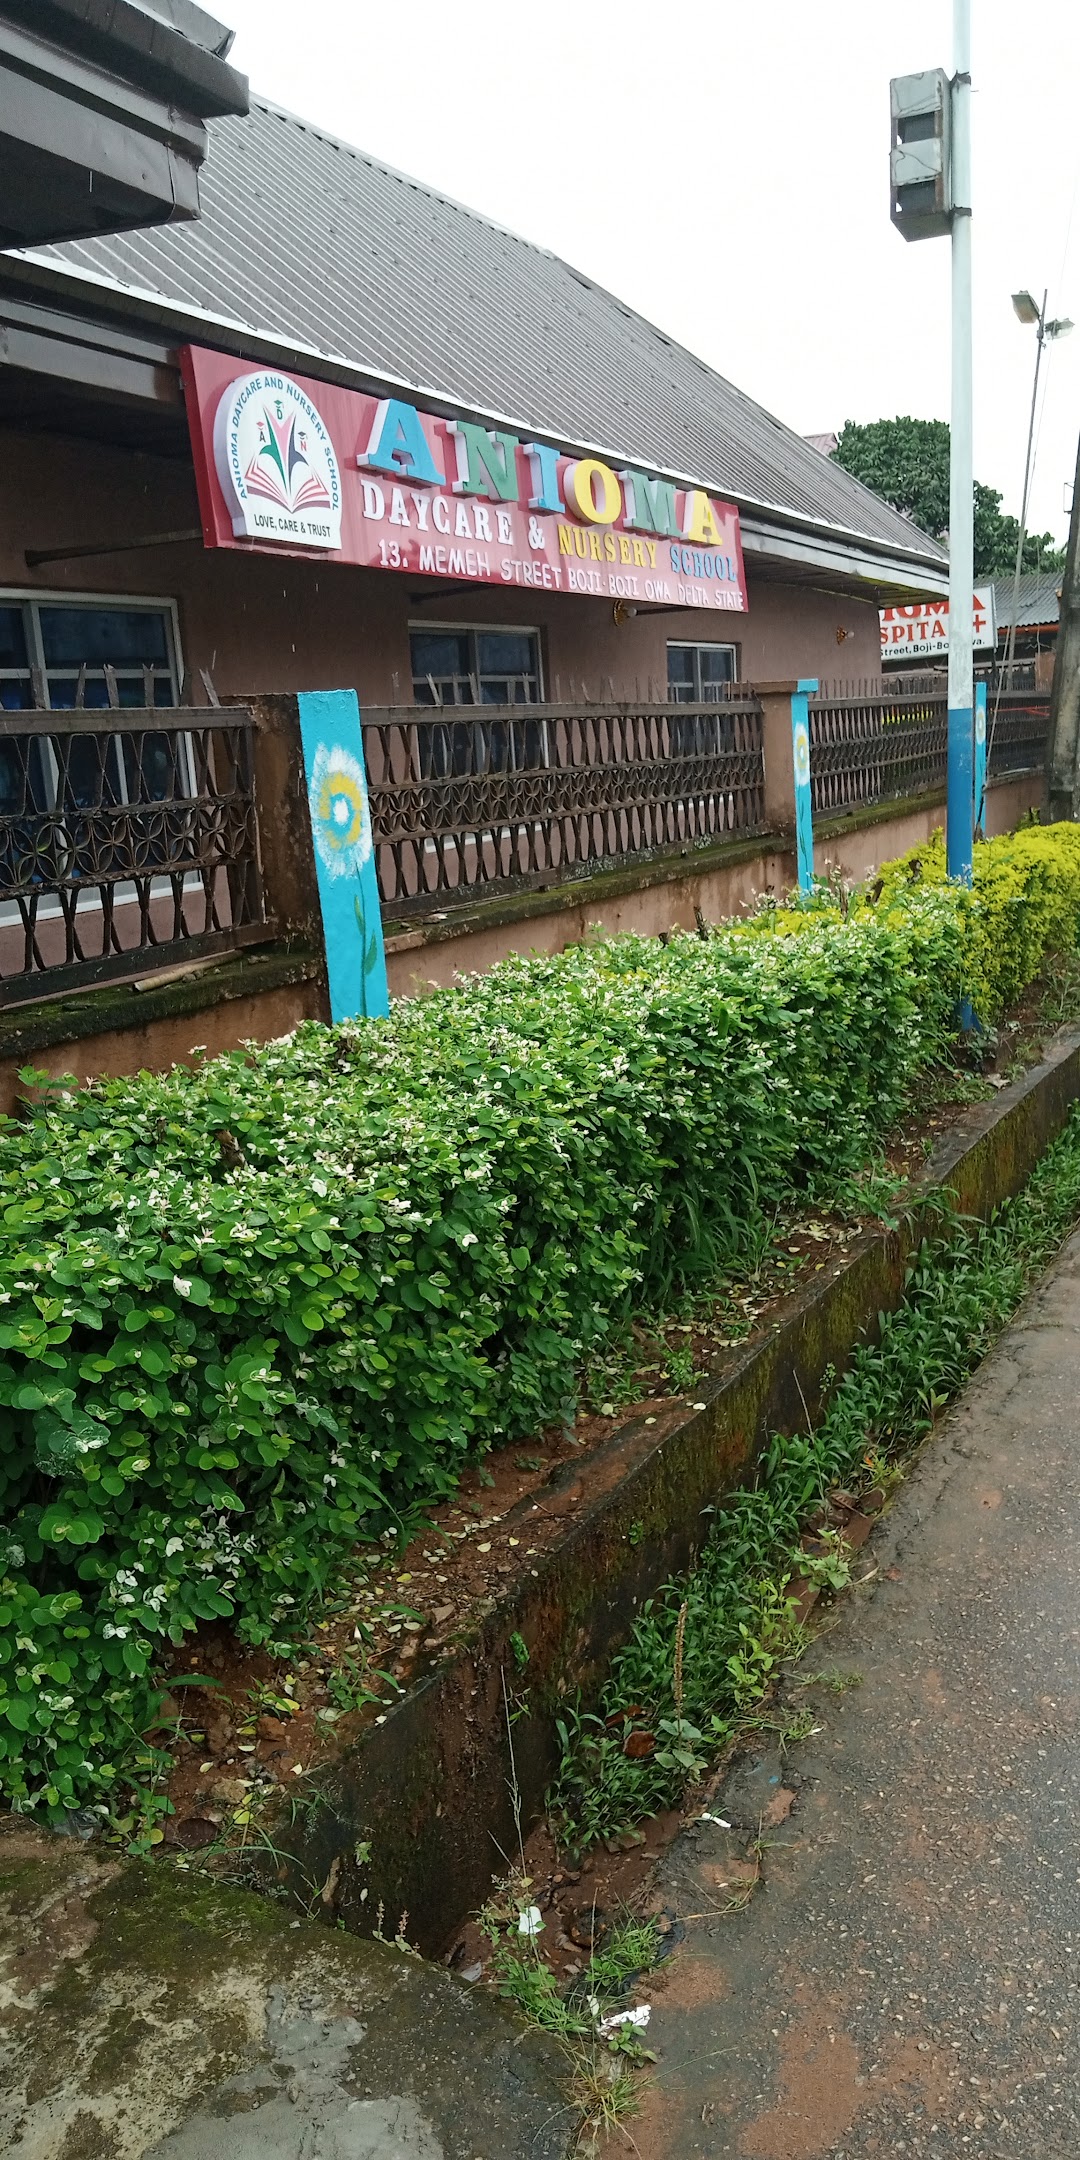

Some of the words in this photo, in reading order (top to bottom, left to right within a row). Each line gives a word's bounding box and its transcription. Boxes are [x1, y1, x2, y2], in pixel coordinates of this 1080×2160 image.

[264, 376, 284, 390] AND
[232, 378, 262, 428] DAYCARE
[276, 408, 283, 420] D
[286, 383, 326, 441] NURSERY
[259, 430, 267, 443] A
[300, 440, 307, 452] N
[231, 433, 247, 499] ANIOMA
[324, 447, 339, 511] SCHOOL
[356, 398, 723, 546] ANIOMA
[254, 514, 278, 531] LOVE,
[278, 518, 299, 532] CARE
[300, 523, 306, 533] &
[307, 523, 331, 537] TRUST
[360, 479, 514, 546] DAYCARE
[528, 515, 546, 550] &
[557, 524, 657, 569] NURSERY
[669, 545, 737, 582] SCHOOL
[419, 544, 491, 577] MEMEH
[500, 557, 562, 589] STREET
[644, 580, 671, 600] OWA
[678, 583, 709, 606] DELTA
[714, 589, 745, 611] STATE
[880, 619, 946, 645] SPITA
[913, 641, 949, 653] Boji-Bo
